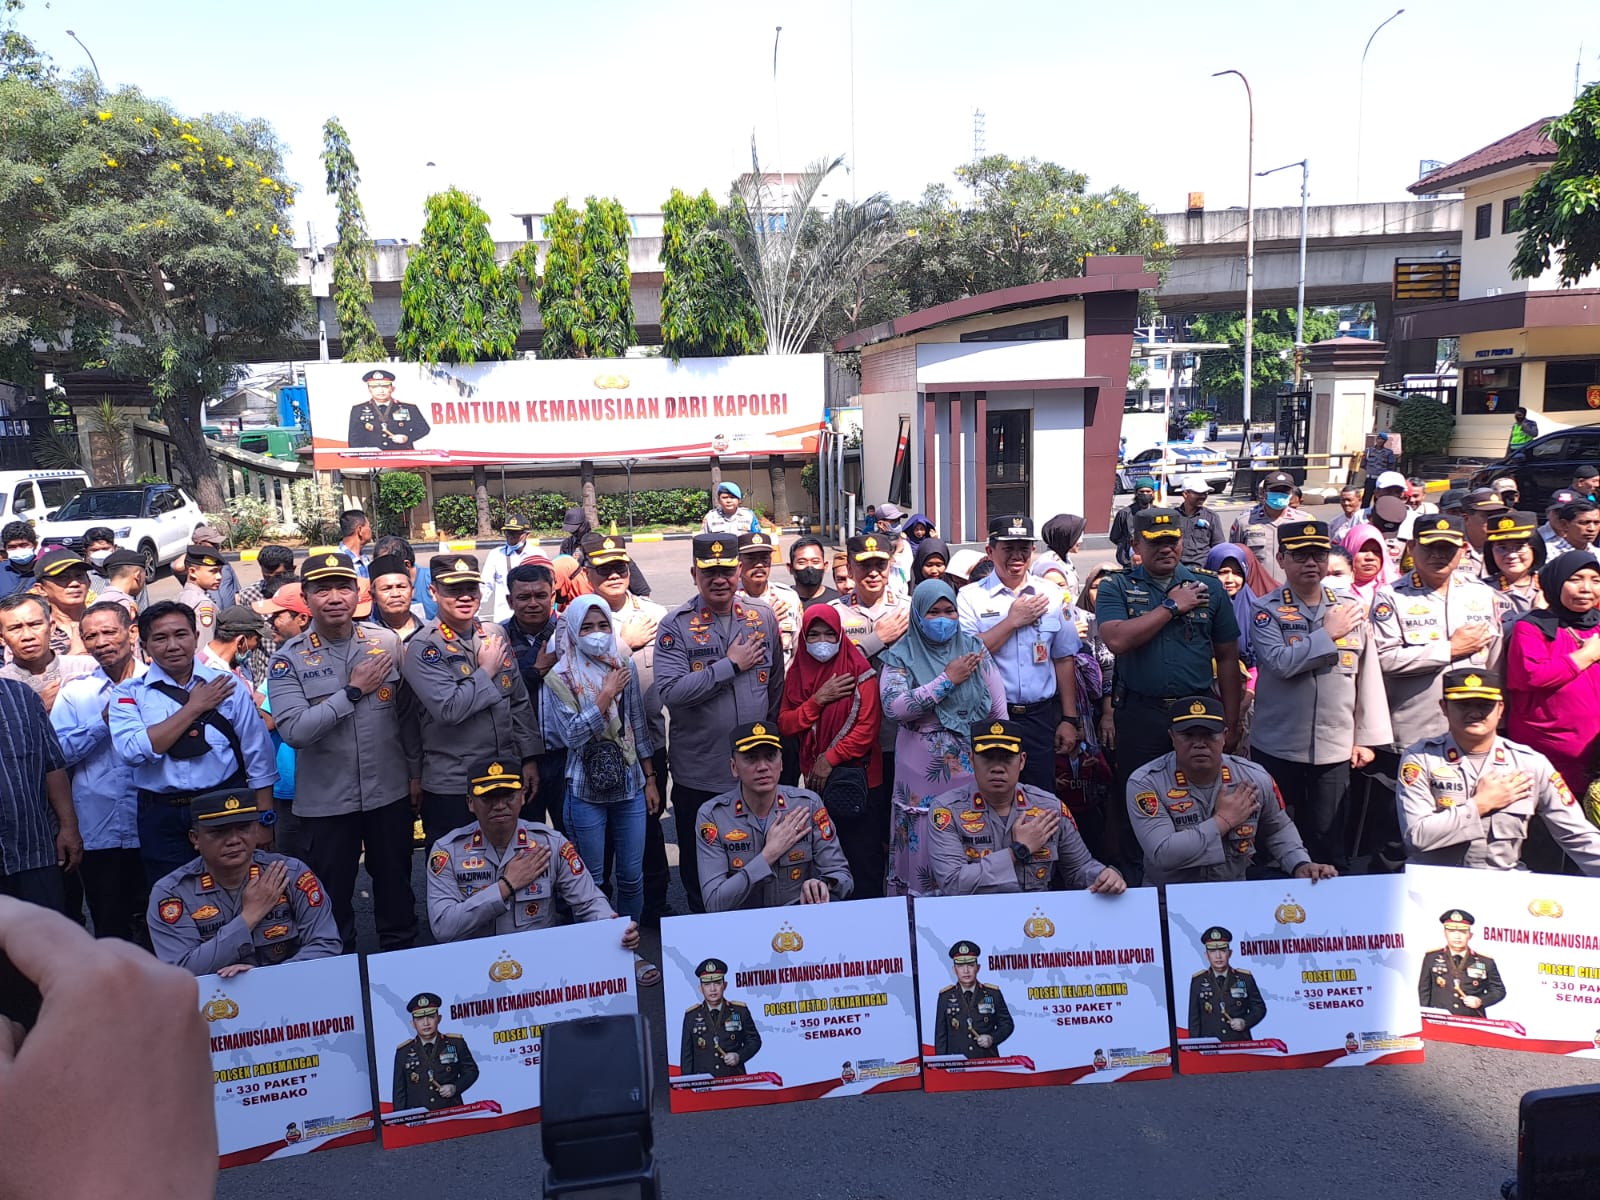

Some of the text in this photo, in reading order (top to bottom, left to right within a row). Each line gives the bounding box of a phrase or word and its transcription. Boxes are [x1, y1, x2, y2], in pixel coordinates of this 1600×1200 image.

[431, 393, 788, 424] BANTUAN KEMANUSIAAN DARI KAPOLRI
[1406, 618, 1437, 627] MALADI
[303, 668, 333, 679] ADE YS
[1430, 780, 1463, 792] HARIS
[724, 842, 751, 851] BOBBY
[457, 870, 491, 882] NAZIRWAN
[1240, 933, 1405, 956] BANTUAN KEMANUSIAAN DARI KAPOLRI
[1484, 927, 1600, 950] BANTUAN KEMANUSIAA
[988, 948, 1155, 971] BANTUAN KEMANUSIAAN DARI KAPOLRI
[735, 957, 903, 988] BANTUAN KEMANUSIAAN DARI KAPOLRI
[1301, 968, 1357, 983] POLSEK KOJA
[1538, 962, 1600, 979] POLSEK CILI
[1028, 982, 1128, 1000] POLSEK KELAPA GADING
[1304, 988, 1323, 998] 330
[1326, 986, 1363, 997] PAKET
[1552, 981, 1575, 991] 330
[450, 977, 627, 1020] BANTUAN KEMANUSIAAN DARI KAPOLRI
[764, 993, 888, 1016] POLSEK METRO PENJARINGAN
[1308, 999, 1364, 1010] SEMBAKO
[1051, 1004, 1072, 1014] 330
[1075, 1002, 1113, 1012] PAKET
[800, 1018, 820, 1028] 350
[824, 1014, 861, 1026] PAKET
[1056, 1015, 1113, 1026] SEMBAKO
[210, 1015, 355, 1053] KEMANUSIAAN DARI KAPOLRI
[493, 1027, 528, 1045] POLSEK
[804, 1026, 862, 1040] SEMBAKO
[519, 1043, 541, 1055] 330
[214, 1054, 320, 1083] POLSEK PADEMANGAN
[236, 1083, 260, 1095] 330
[264, 1075, 308, 1090] PAKET
[242, 1087, 308, 1106] SEMBAKO
